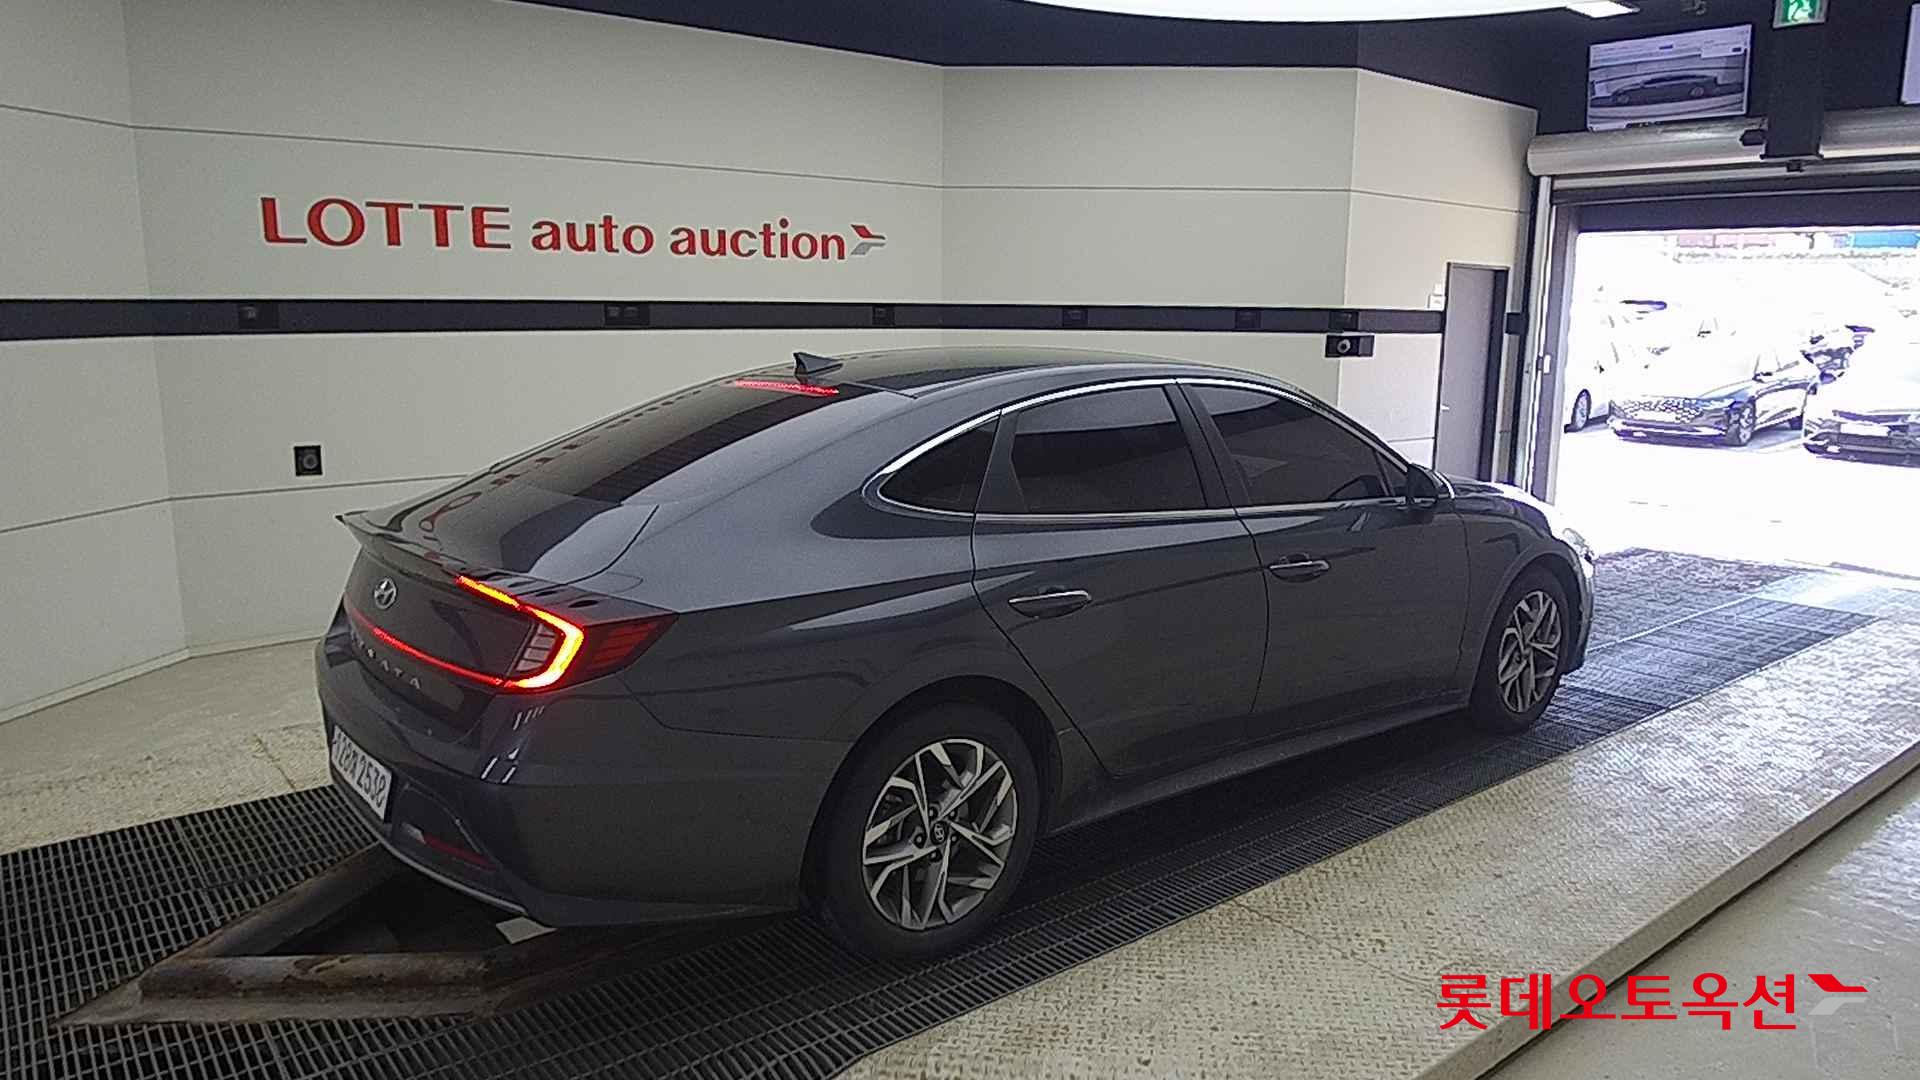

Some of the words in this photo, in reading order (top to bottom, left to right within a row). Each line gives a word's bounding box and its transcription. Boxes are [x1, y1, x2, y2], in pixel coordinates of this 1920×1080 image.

[260, 197, 511, 249] LOTTE
[531, 214, 654, 254] auto
[669, 217, 846, 260] auction
